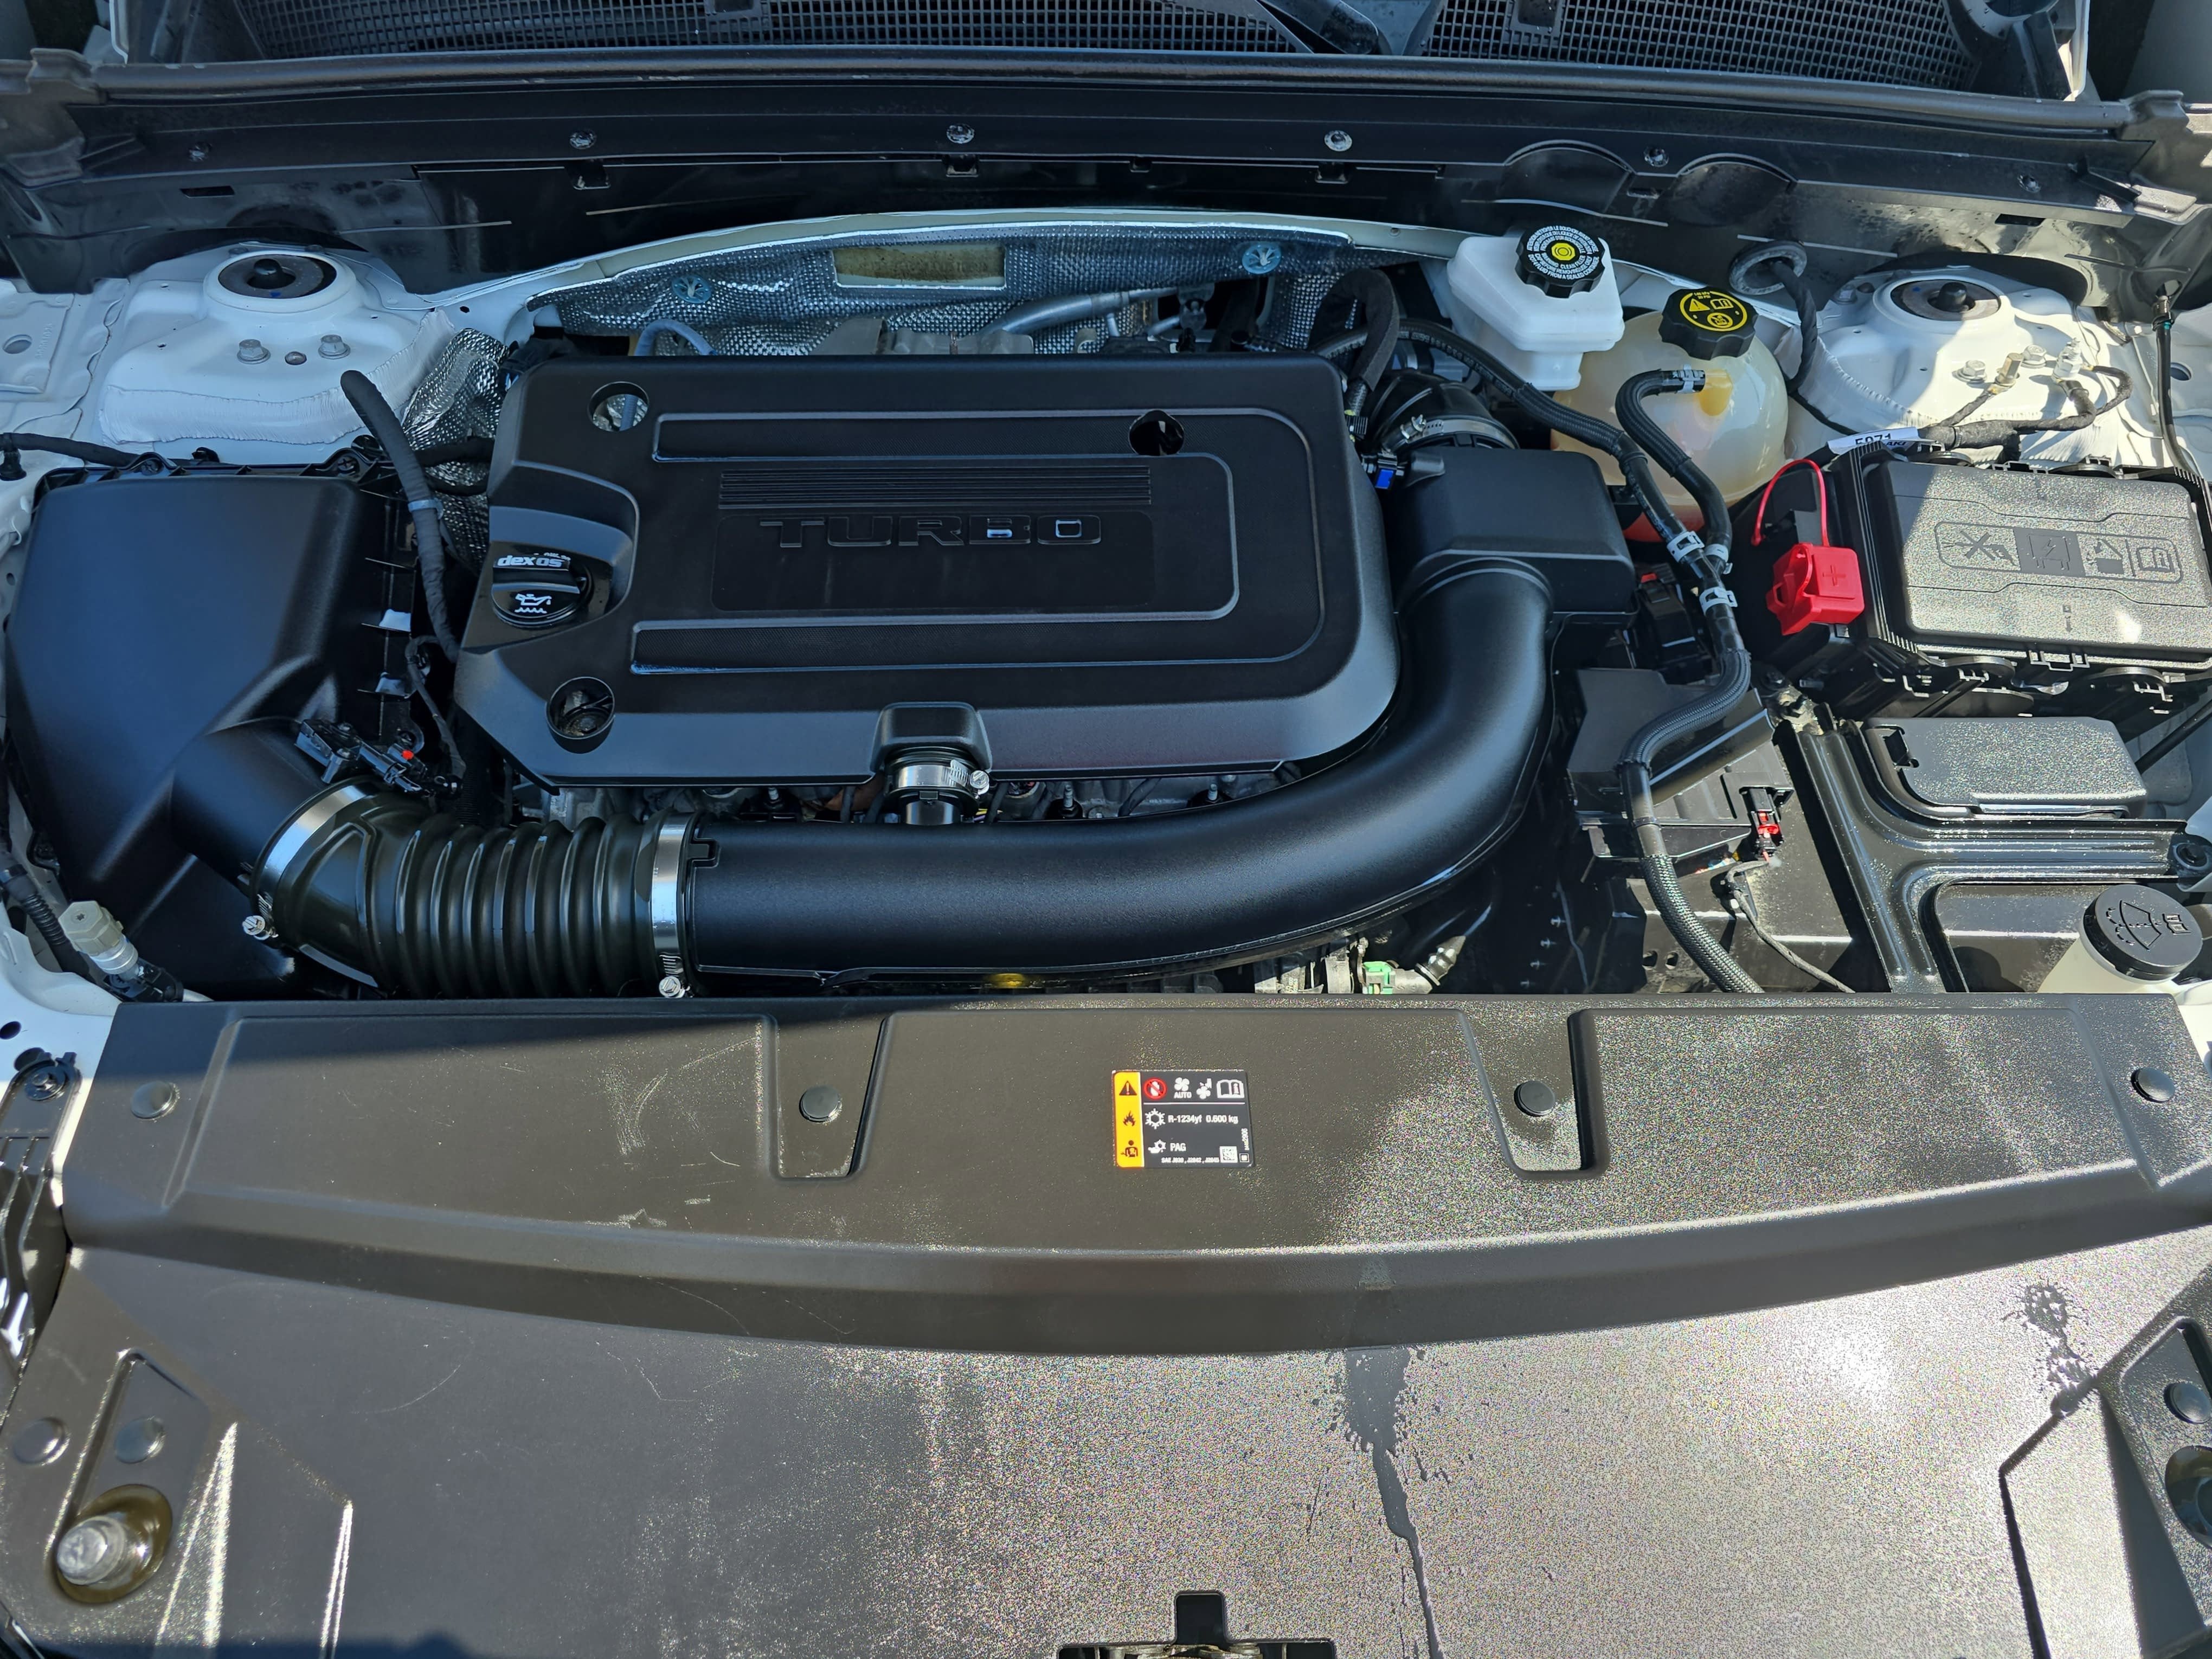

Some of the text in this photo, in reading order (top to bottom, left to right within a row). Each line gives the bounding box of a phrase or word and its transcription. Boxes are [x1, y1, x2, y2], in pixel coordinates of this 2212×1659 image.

[1534, 263, 1549, 274] FLUID
[1546, 270, 1562, 279] FROM
[759, 515, 1102, 548] TURBO
[497, 555, 565, 568] dexos
[1173, 1091, 1192, 1099] AUTO
[1167, 1114, 1203, 1124] R-1234yf
[1228, 1114, 1239, 1124] kg
[1169, 1142, 1187, 1152] PAG
